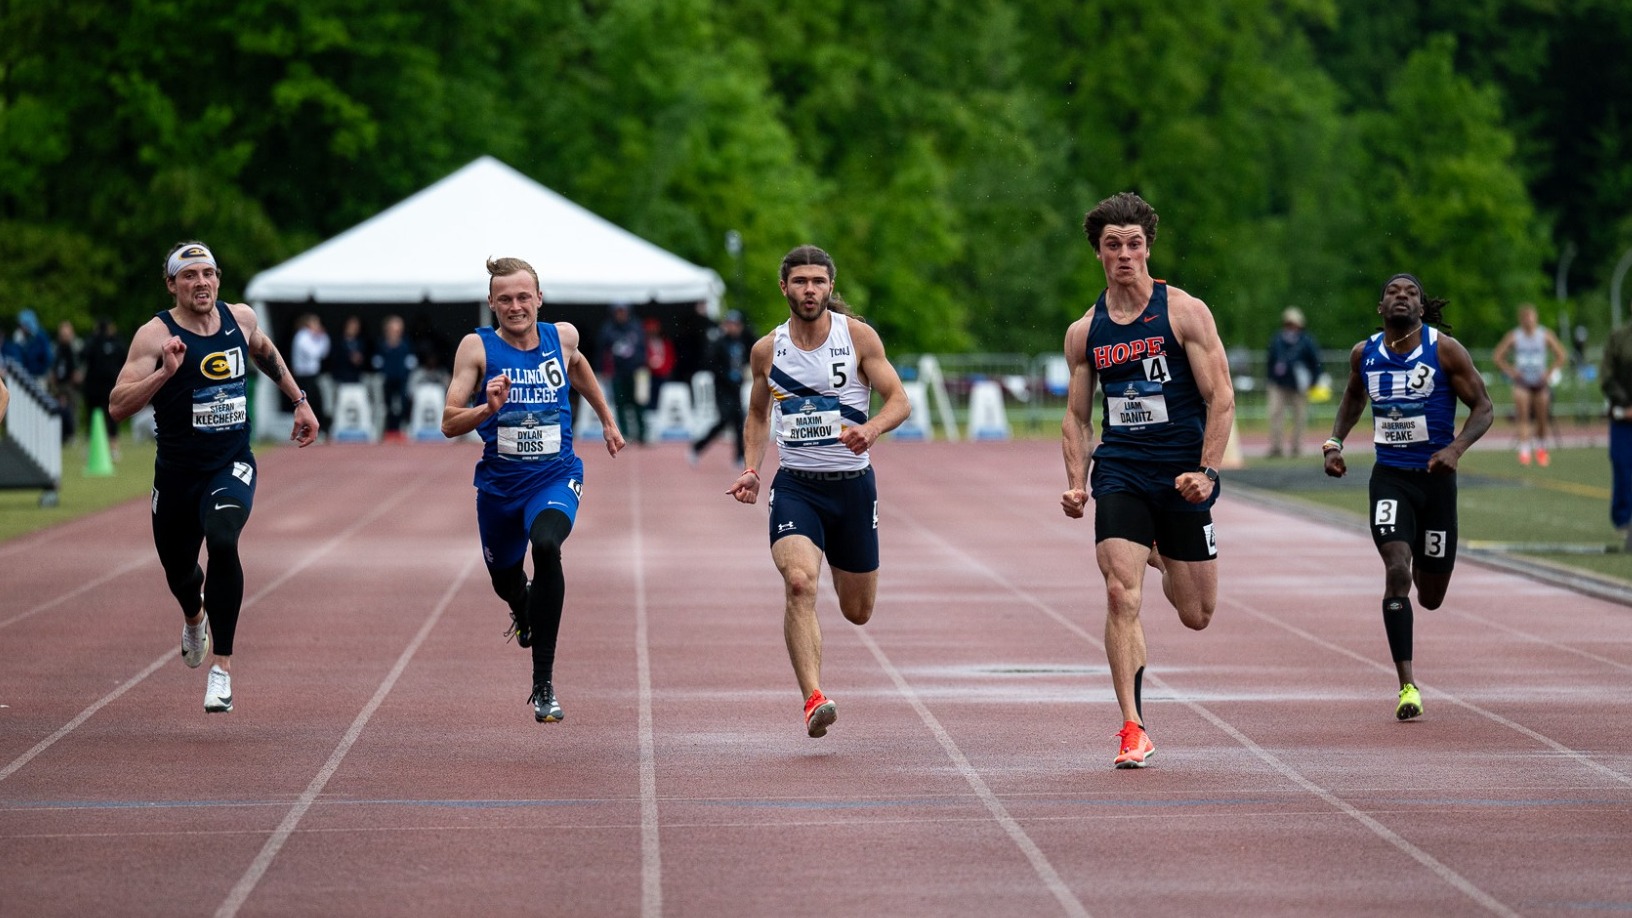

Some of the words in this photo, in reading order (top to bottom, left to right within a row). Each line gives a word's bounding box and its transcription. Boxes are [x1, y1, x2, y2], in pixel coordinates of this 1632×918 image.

[829, 346, 850, 358] TCNJ
[1093, 336, 1167, 369] HOPE
[228, 349, 240, 376] 7
[1150, 358, 1166, 383] 4
[545, 360, 562, 387] 6
[832, 362, 847, 388] 5
[1411, 365, 1430, 389] 3
[504, 387, 559, 404] OLLEGE
[210, 402, 235, 413] STEFAN
[1124, 401, 1143, 411] LIAM
[796, 415, 823, 426] MAXIM
[1120, 410, 1153, 424] DANITZ
[517, 430, 543, 440] DYLAN
[790, 425, 832, 440] RYCHKOV
[1385, 430, 1414, 442] PEAKE
[516, 441, 544, 453] DOSS
[1379, 501, 1393, 523] 3
[1428, 532, 1442, 556] 3
